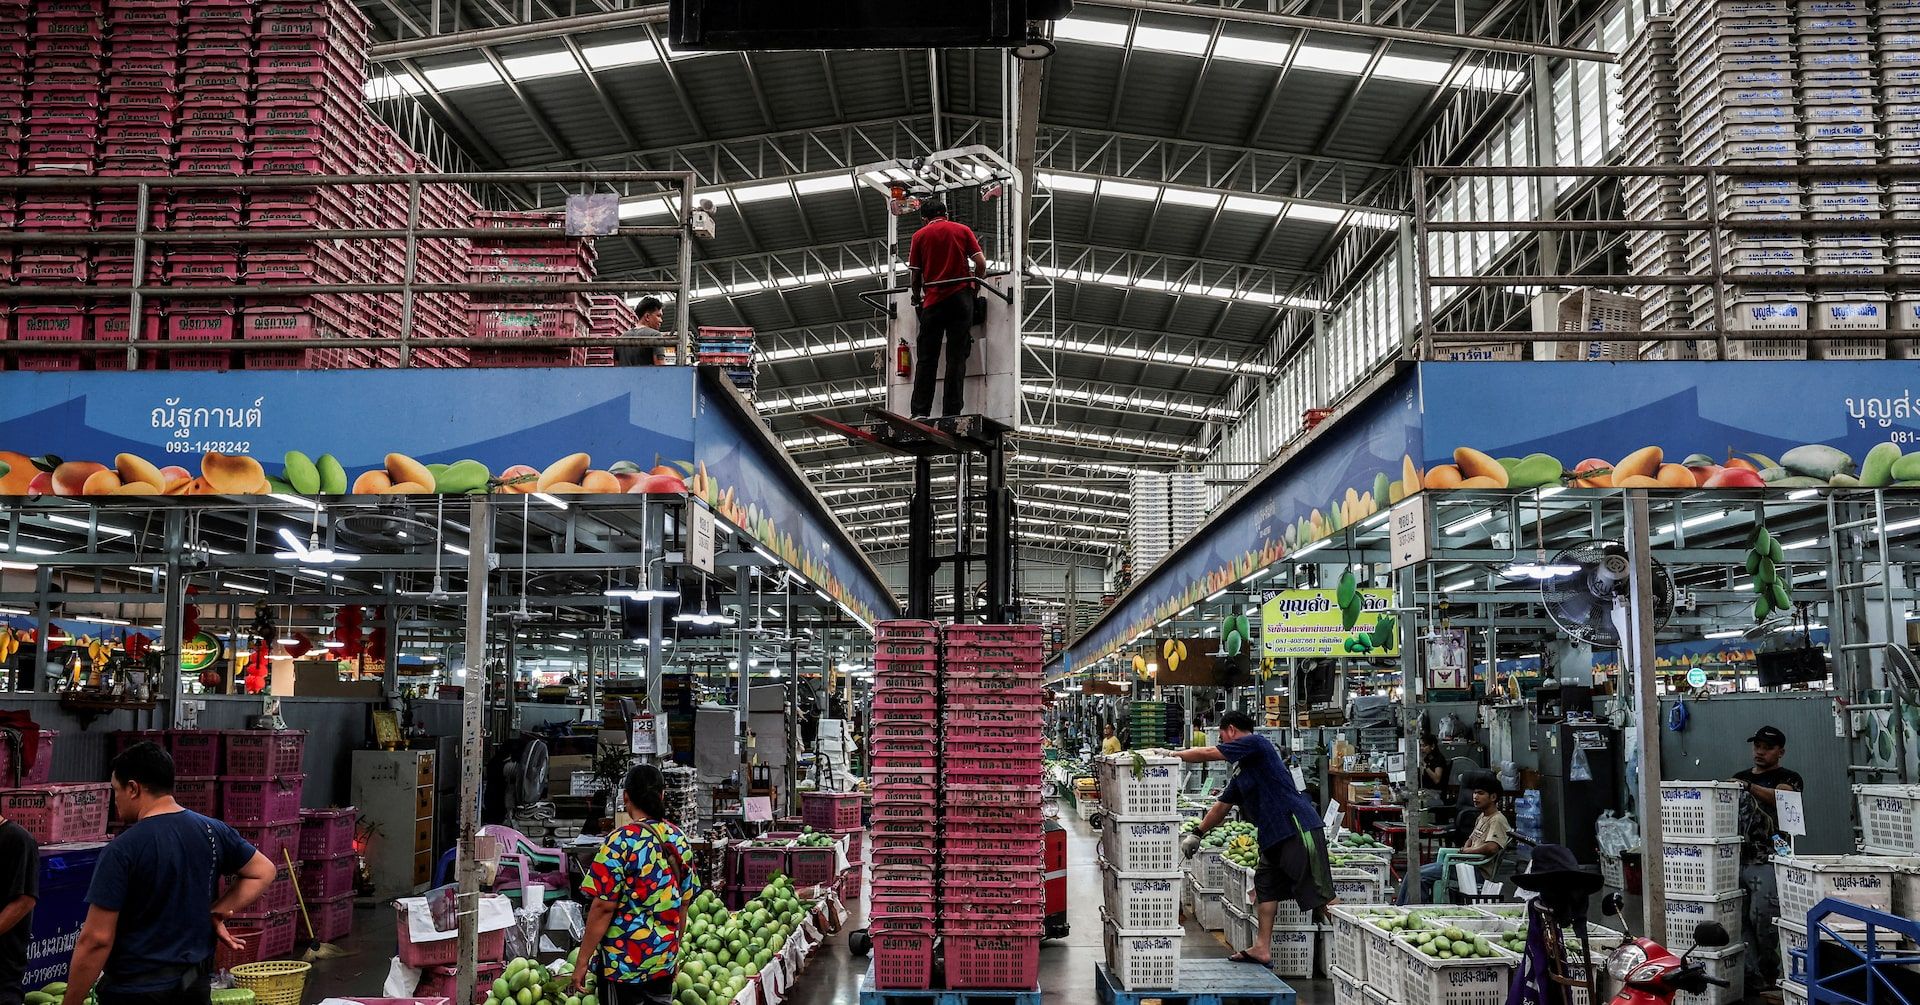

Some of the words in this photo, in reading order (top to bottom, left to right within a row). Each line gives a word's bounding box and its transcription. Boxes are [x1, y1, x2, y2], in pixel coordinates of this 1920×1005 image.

[151, 397, 264, 438] ณัฐกานต์
[166, 441, 250, 454] 093-1428242
[1279, 593, 1388, 619] บุญส่ง-คิด
[639, 721, 653, 730] 29
